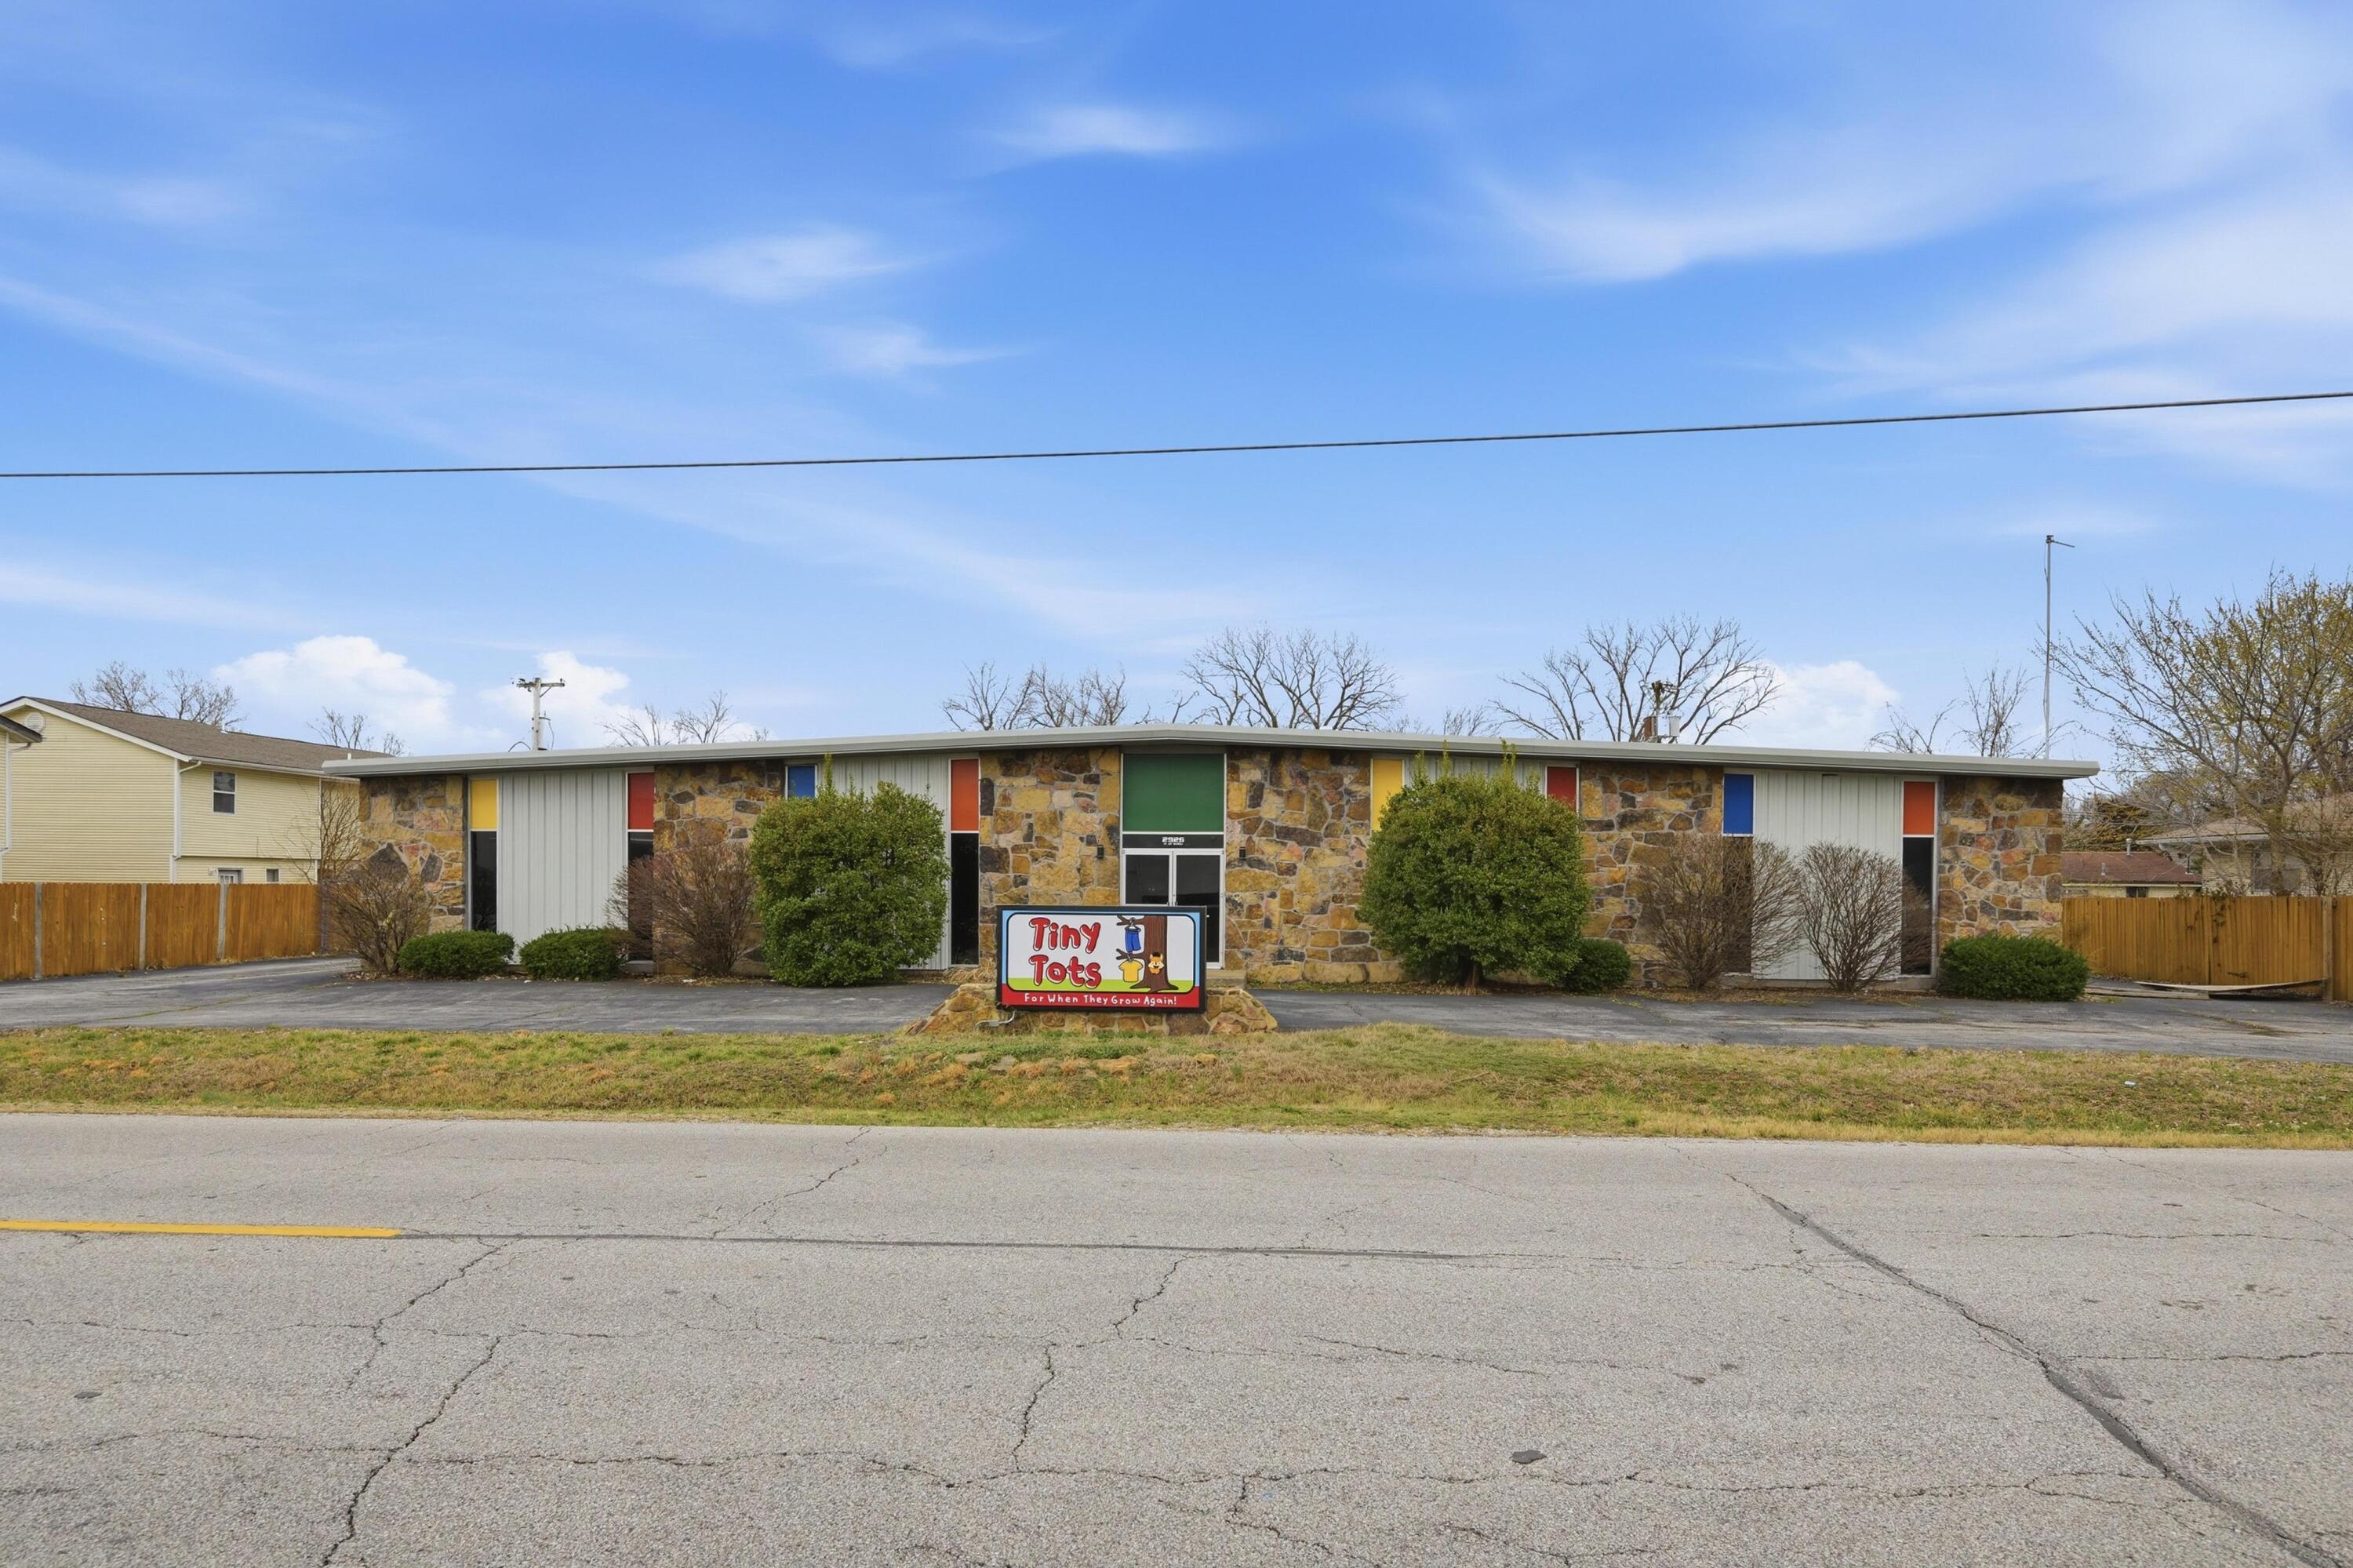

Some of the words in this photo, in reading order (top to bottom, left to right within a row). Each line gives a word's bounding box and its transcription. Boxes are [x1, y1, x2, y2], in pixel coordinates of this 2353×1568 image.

[1028, 916, 1101, 954] Tiny
[1028, 954, 1103, 989] Tots
[1024, 992, 1044, 1002] For
[1047, 994, 1078, 1003] When
[1083, 994, 1108, 1005] They
[1111, 995, 1140, 1004] Grow
[1144, 995, 1177, 1006] Again!
